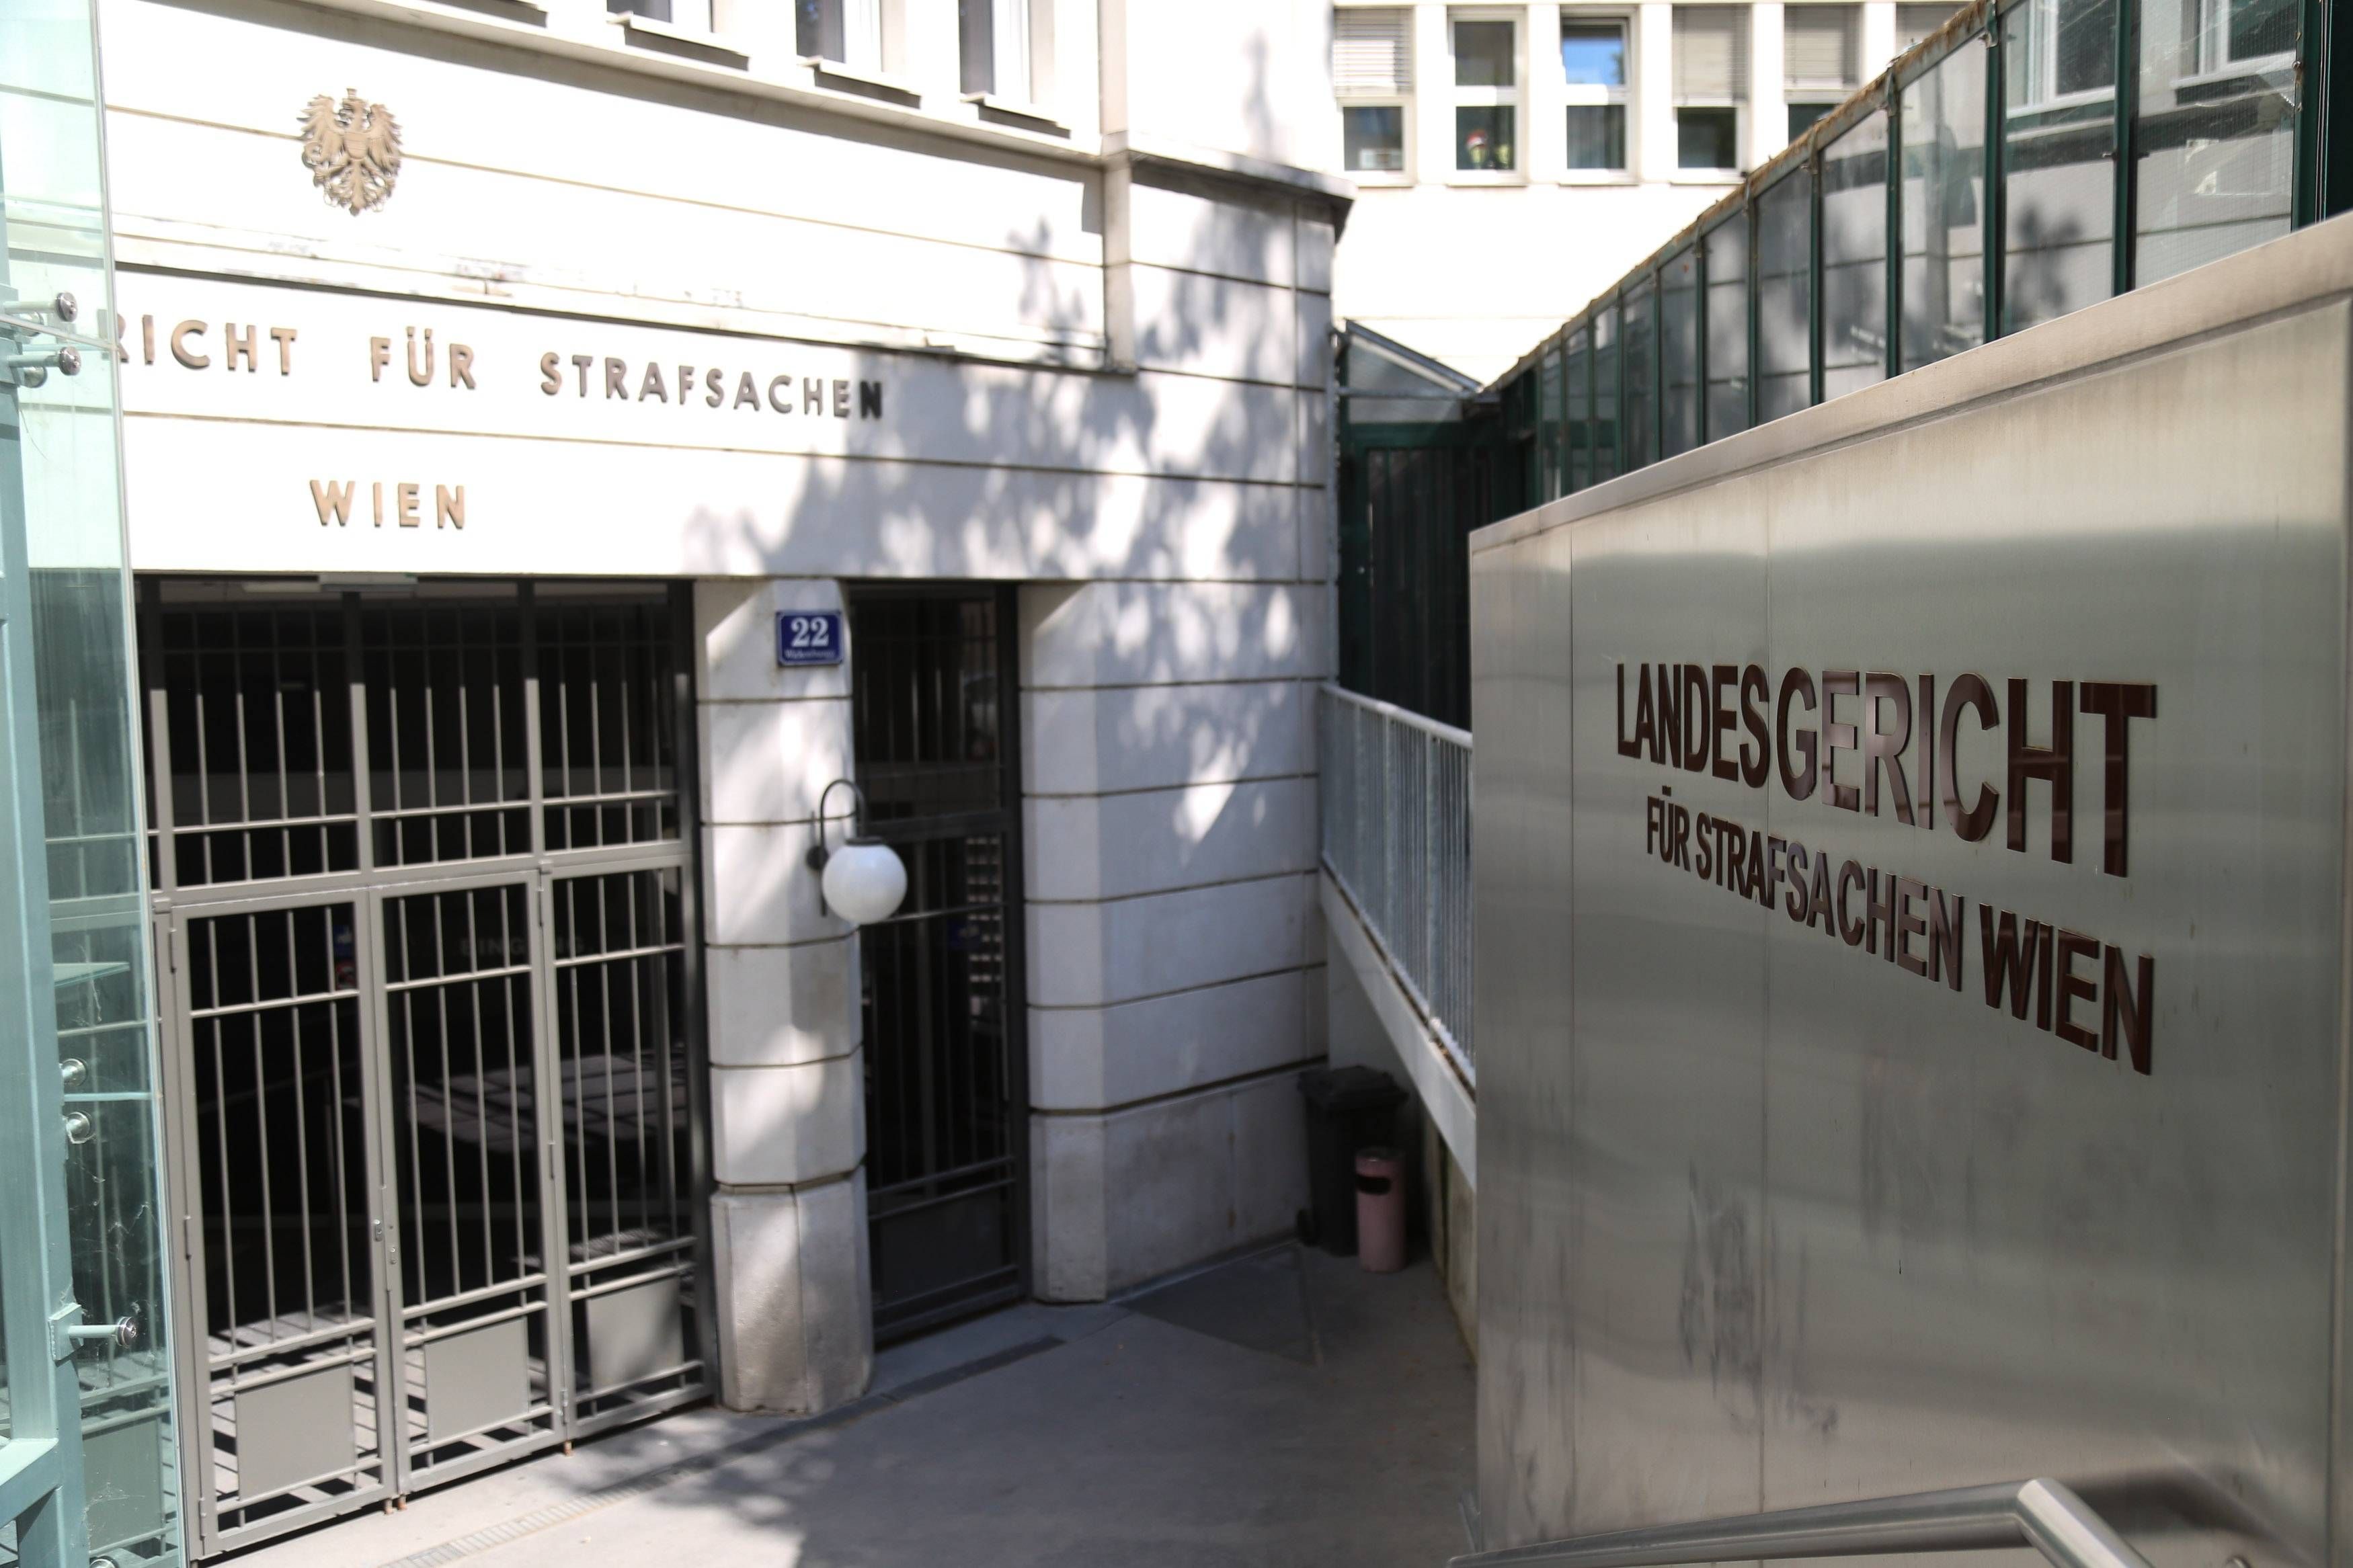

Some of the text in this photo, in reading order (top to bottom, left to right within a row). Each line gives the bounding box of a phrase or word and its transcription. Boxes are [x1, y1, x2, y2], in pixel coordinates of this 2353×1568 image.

[370, 327, 476, 390] FÜR
[541, 352, 882, 419] STRAFSACHEN
[310, 479, 465, 530] WIEN
[791, 616, 829, 647] 22
[1618, 663, 2157, 878] LANDESGERICHT
[1647, 785, 2154, 1076] FÜR STRAFSACHEN WIEN
